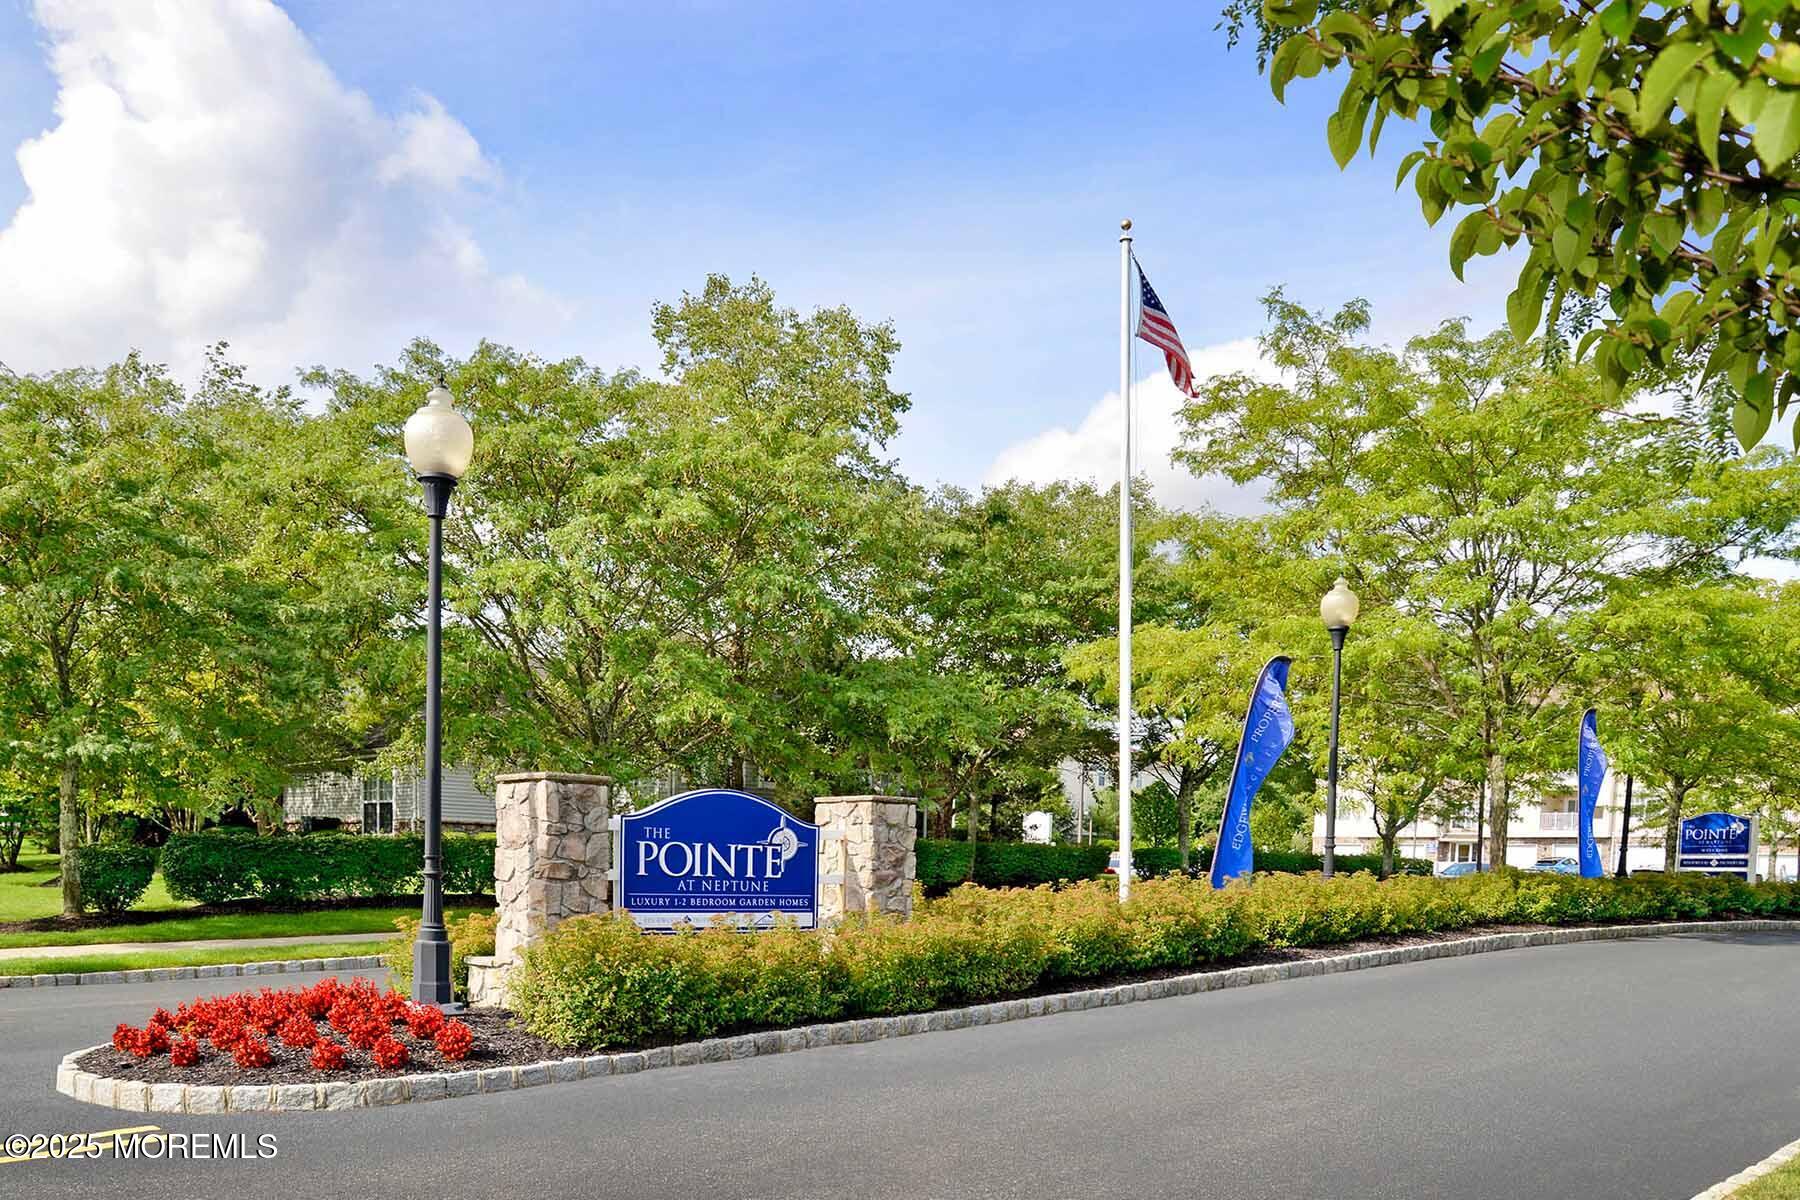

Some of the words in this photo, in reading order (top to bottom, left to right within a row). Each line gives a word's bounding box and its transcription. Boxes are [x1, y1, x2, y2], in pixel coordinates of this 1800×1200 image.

[643, 826, 671, 840] THE
[1685, 828, 1738, 840] POINTE
[635, 840, 783, 879] POINTE
[677, 880, 696, 891] AT
[701, 880, 769, 892] NEPTUNE
[631, 897, 671, 906] LUXURY
[674, 898, 686, 906] 1-2
[690, 898, 736, 906] BEDROOM
[739, 898, 776, 906] GARDEN
[779, 898, 809, 907] HOMES
